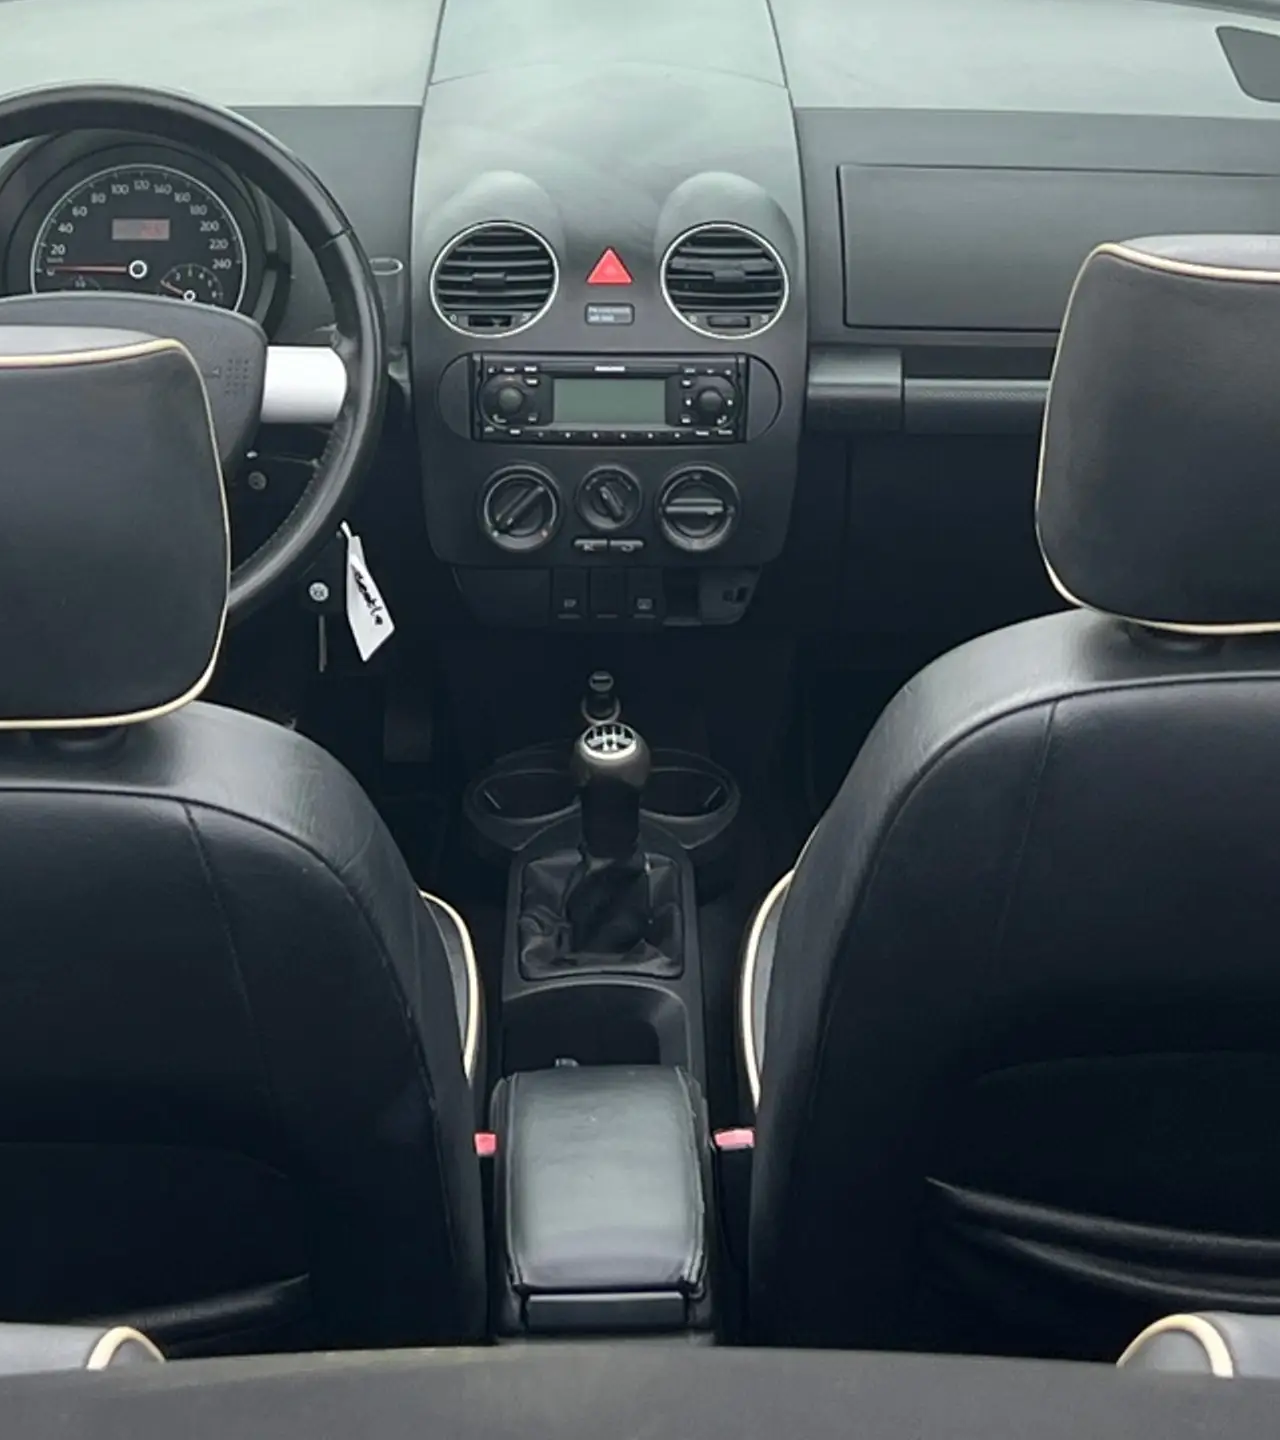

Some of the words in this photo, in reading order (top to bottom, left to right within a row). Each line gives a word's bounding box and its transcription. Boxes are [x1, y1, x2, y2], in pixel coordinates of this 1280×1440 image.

[111, 184, 129, 194] 100
[134, 180, 150, 190] 120
[154, 184, 172, 195] 140
[91, 193, 106, 203] 80
[174, 192, 191, 202] 160
[72, 206, 87, 216] 60
[190, 204, 207, 215] 180
[58, 222, 74, 233] 40
[200, 220, 219, 231] 200
[51, 244, 66, 255] 20
[209, 239, 228, 250] 220
[212, 258, 231, 269] 240
